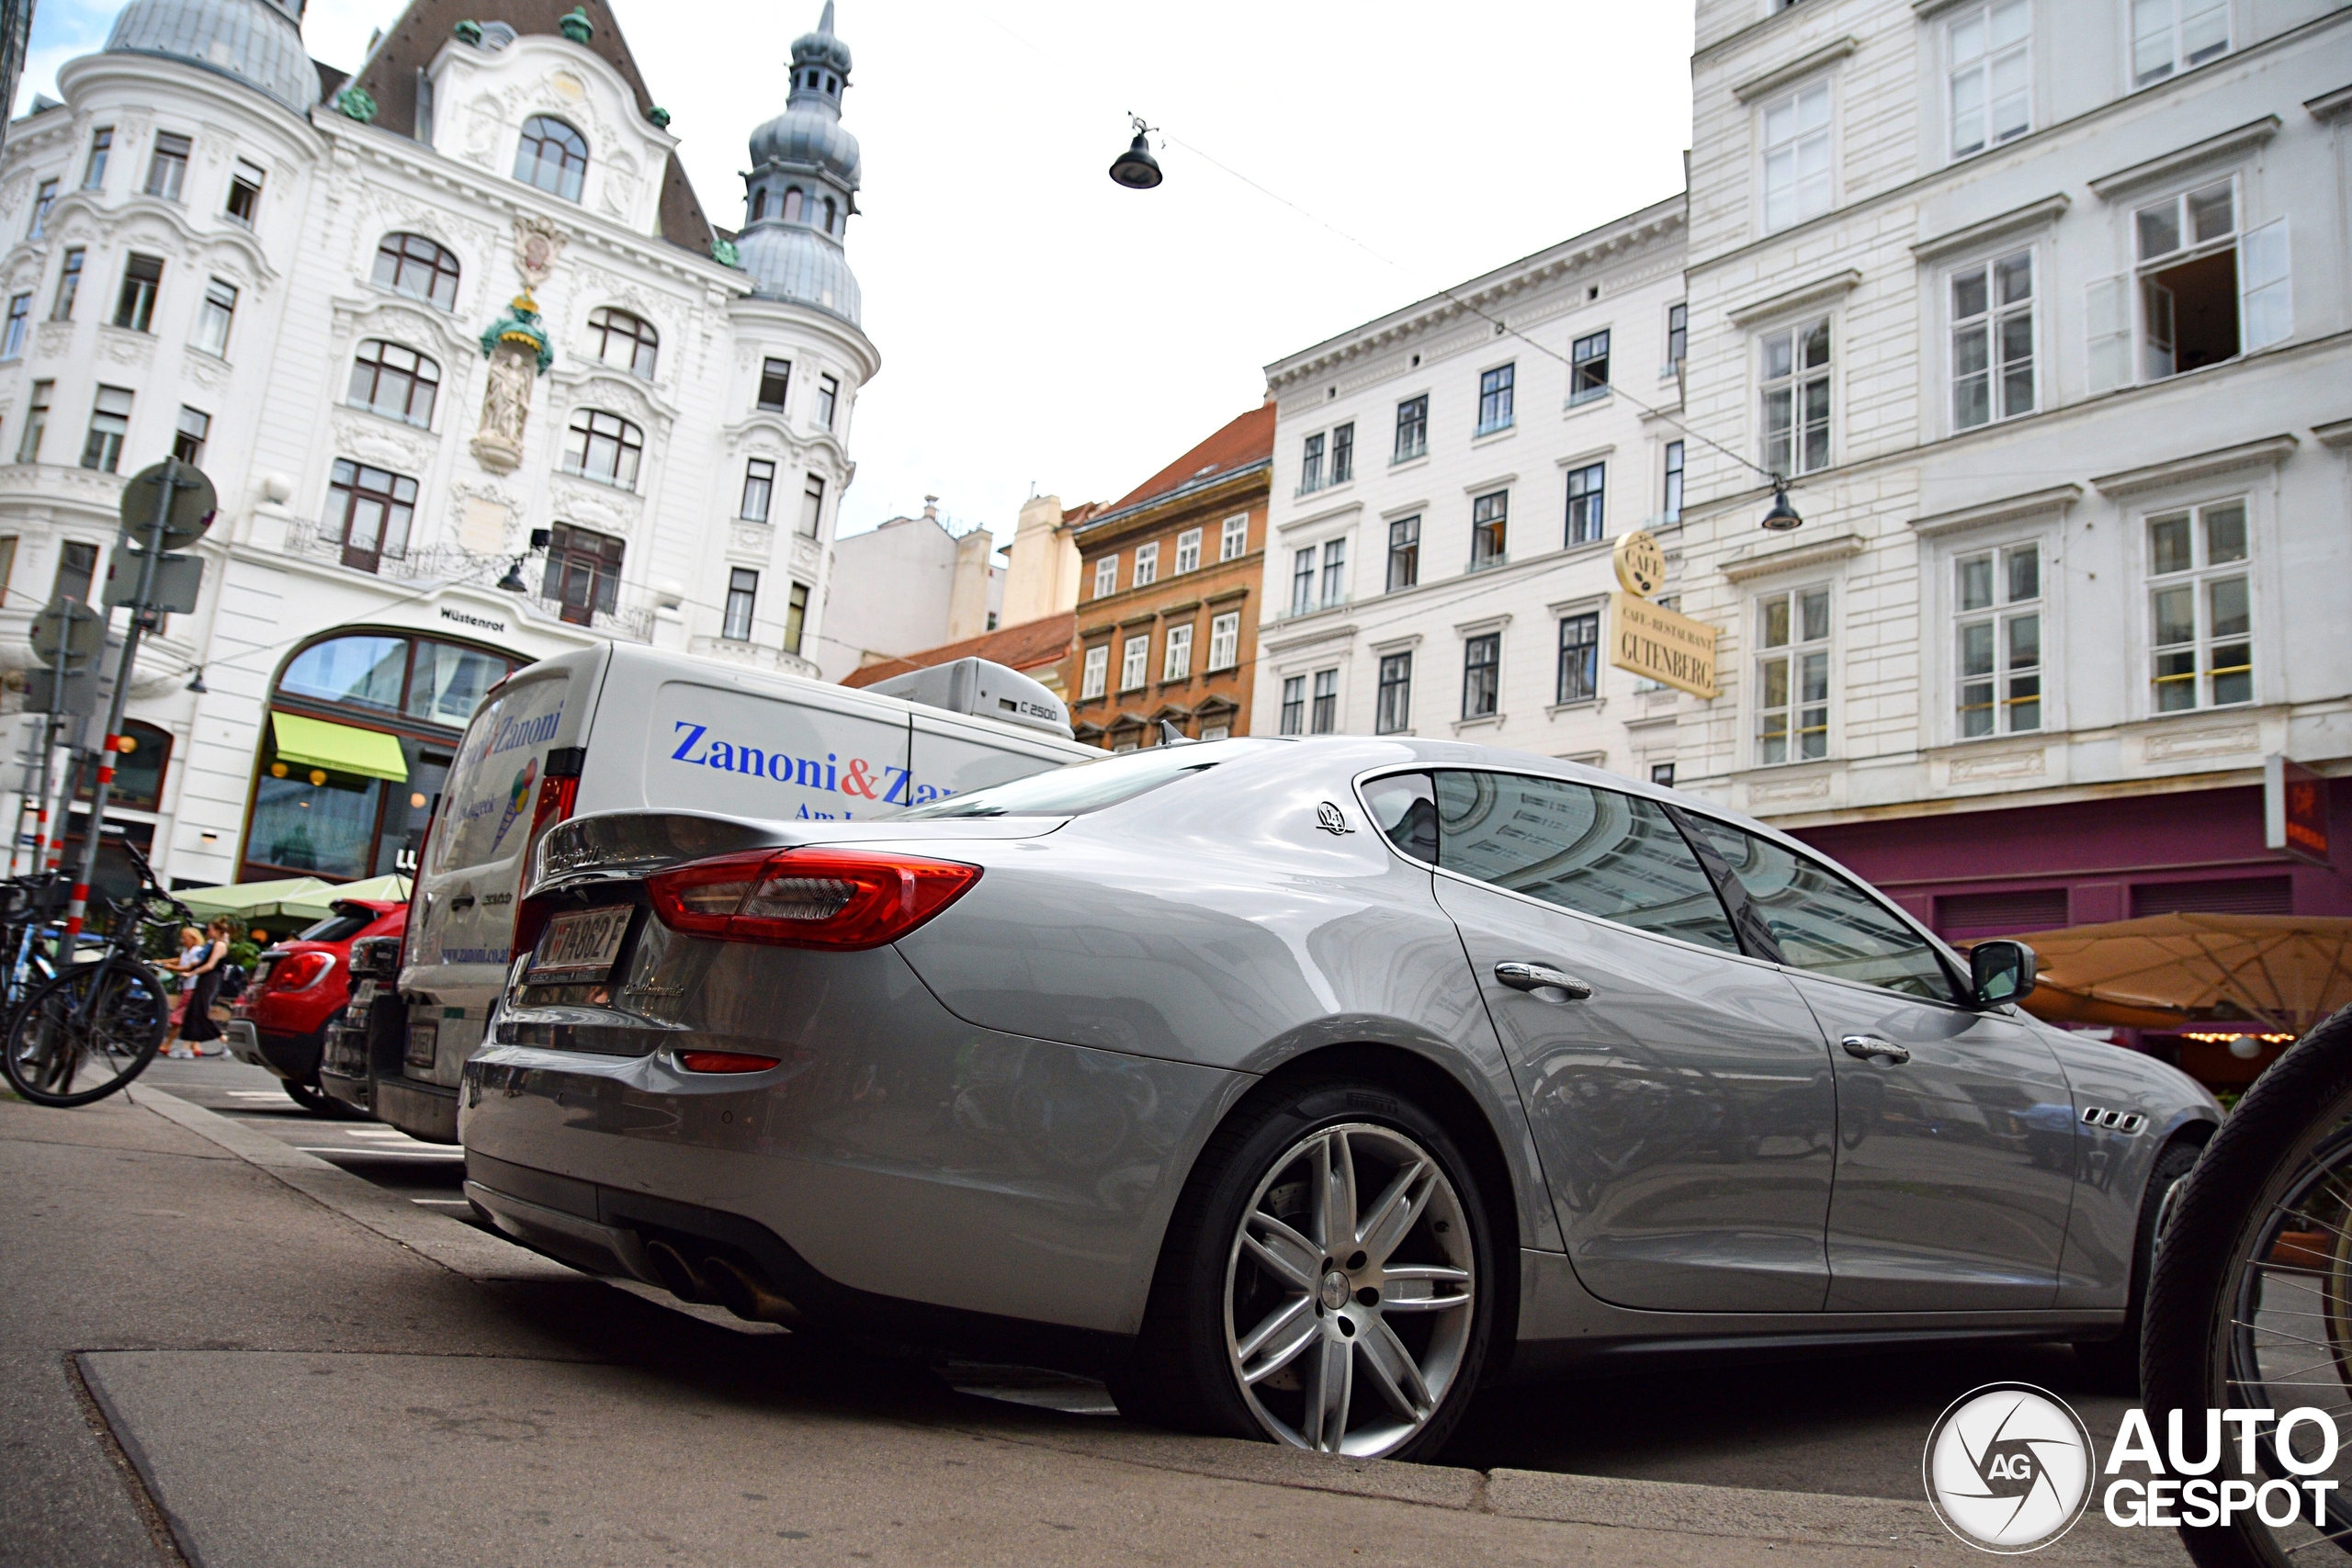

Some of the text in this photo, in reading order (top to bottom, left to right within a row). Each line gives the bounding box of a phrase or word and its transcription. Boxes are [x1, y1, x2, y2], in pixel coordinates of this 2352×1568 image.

[440, 606, 504, 633] Wüstenrot
[1622, 630, 1712, 690] GUTENBERG
[1021, 700, 1057, 722] C 2500
